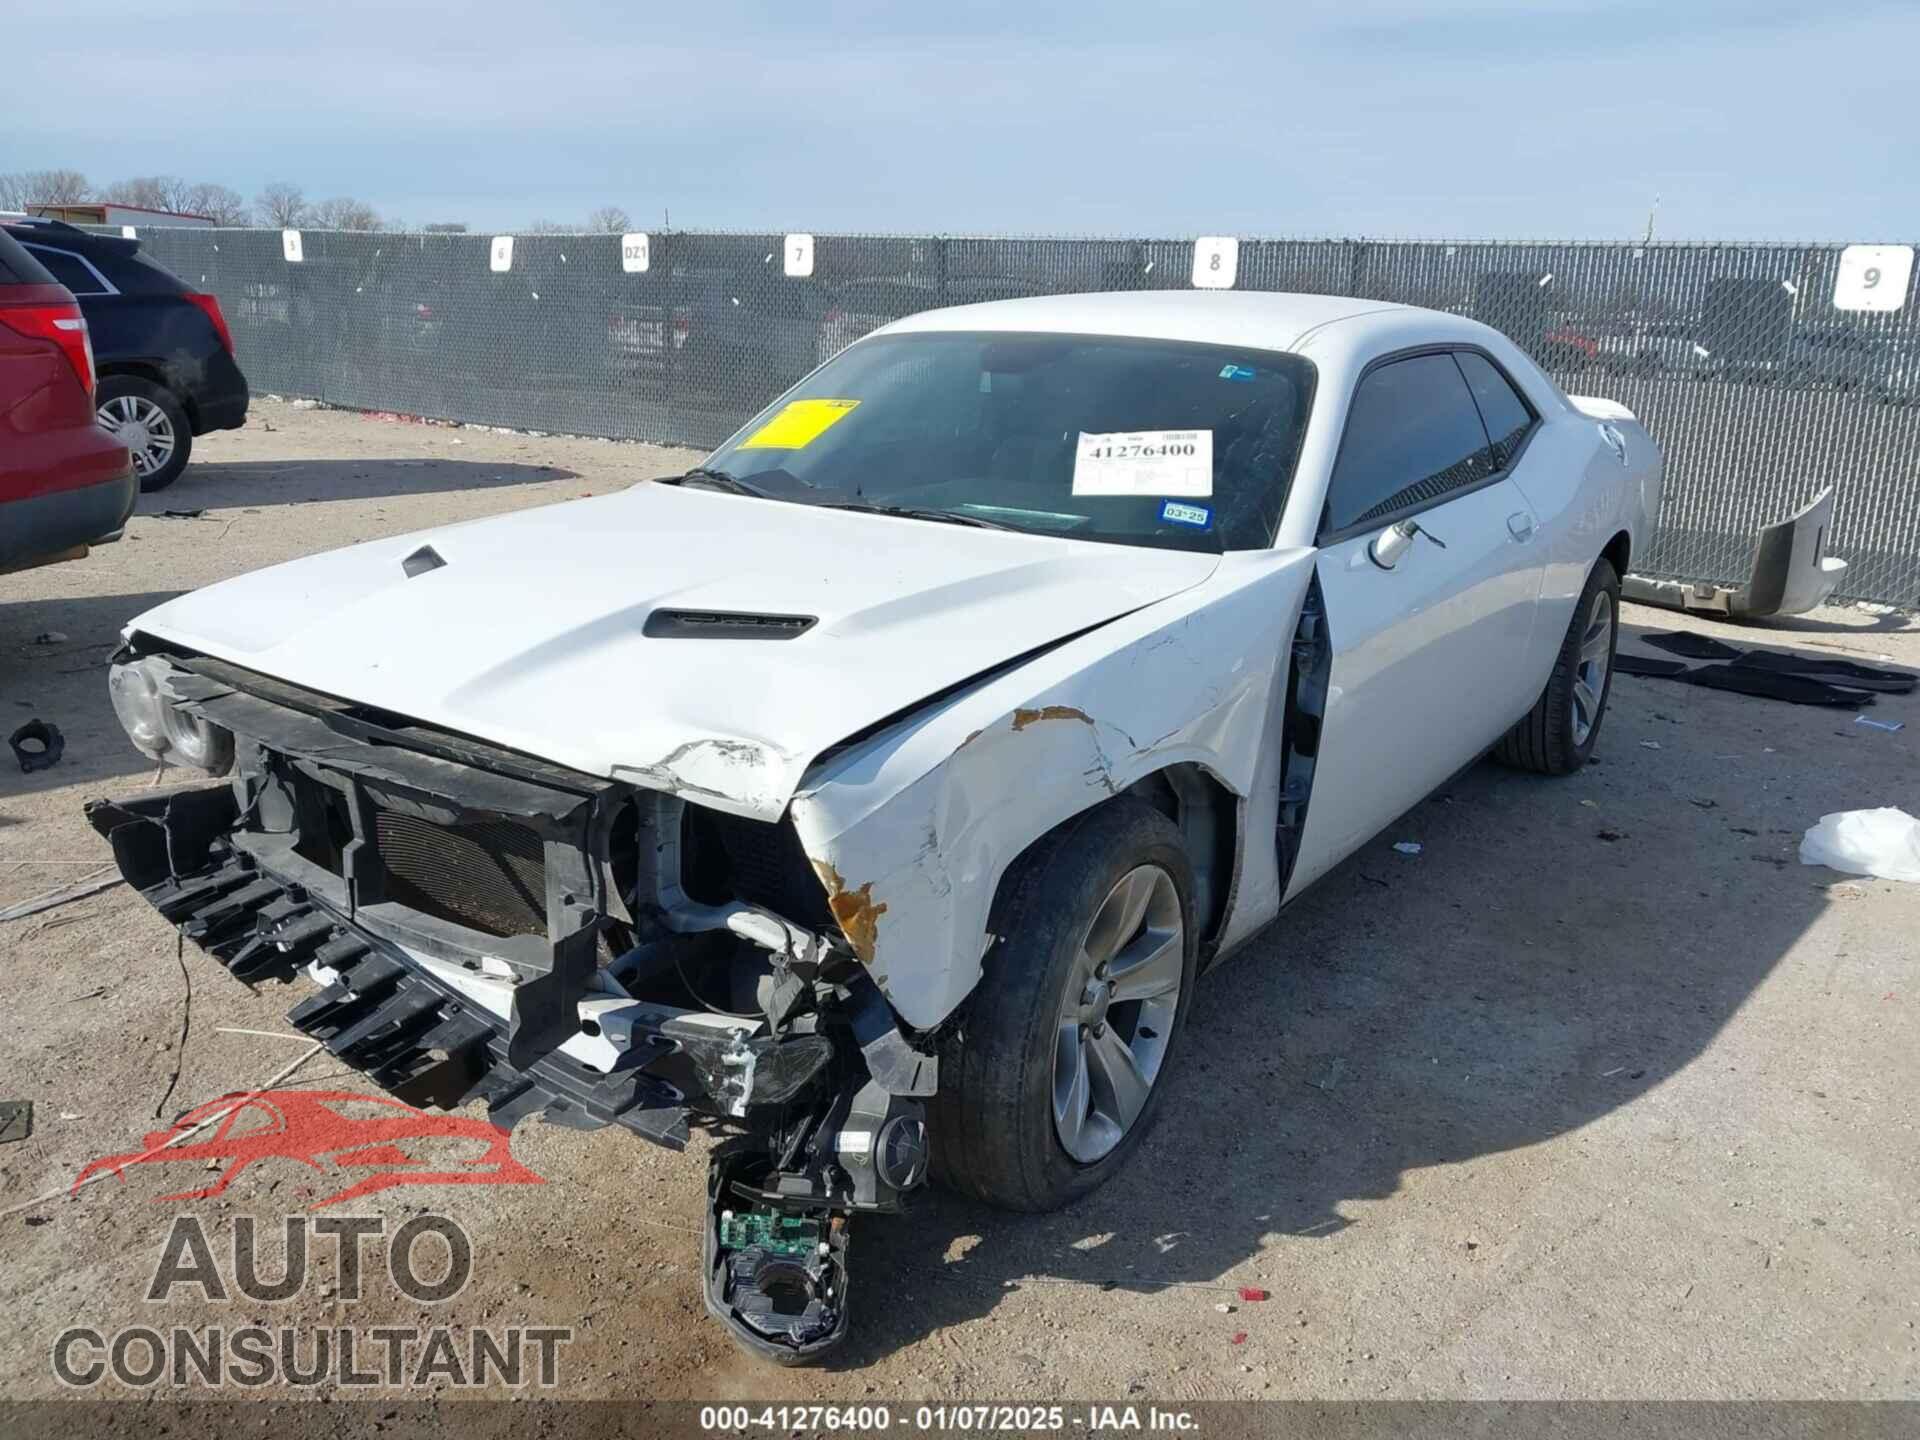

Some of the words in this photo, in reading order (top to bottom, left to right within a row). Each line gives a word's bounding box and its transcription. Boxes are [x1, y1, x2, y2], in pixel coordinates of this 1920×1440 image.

[625, 246, 646, 259] DZ1
[795, 247, 803, 261] 7
[1210, 253, 1220, 271] 8
[1863, 267, 1881, 289] 9
[1089, 444, 1195, 459] 41276400
